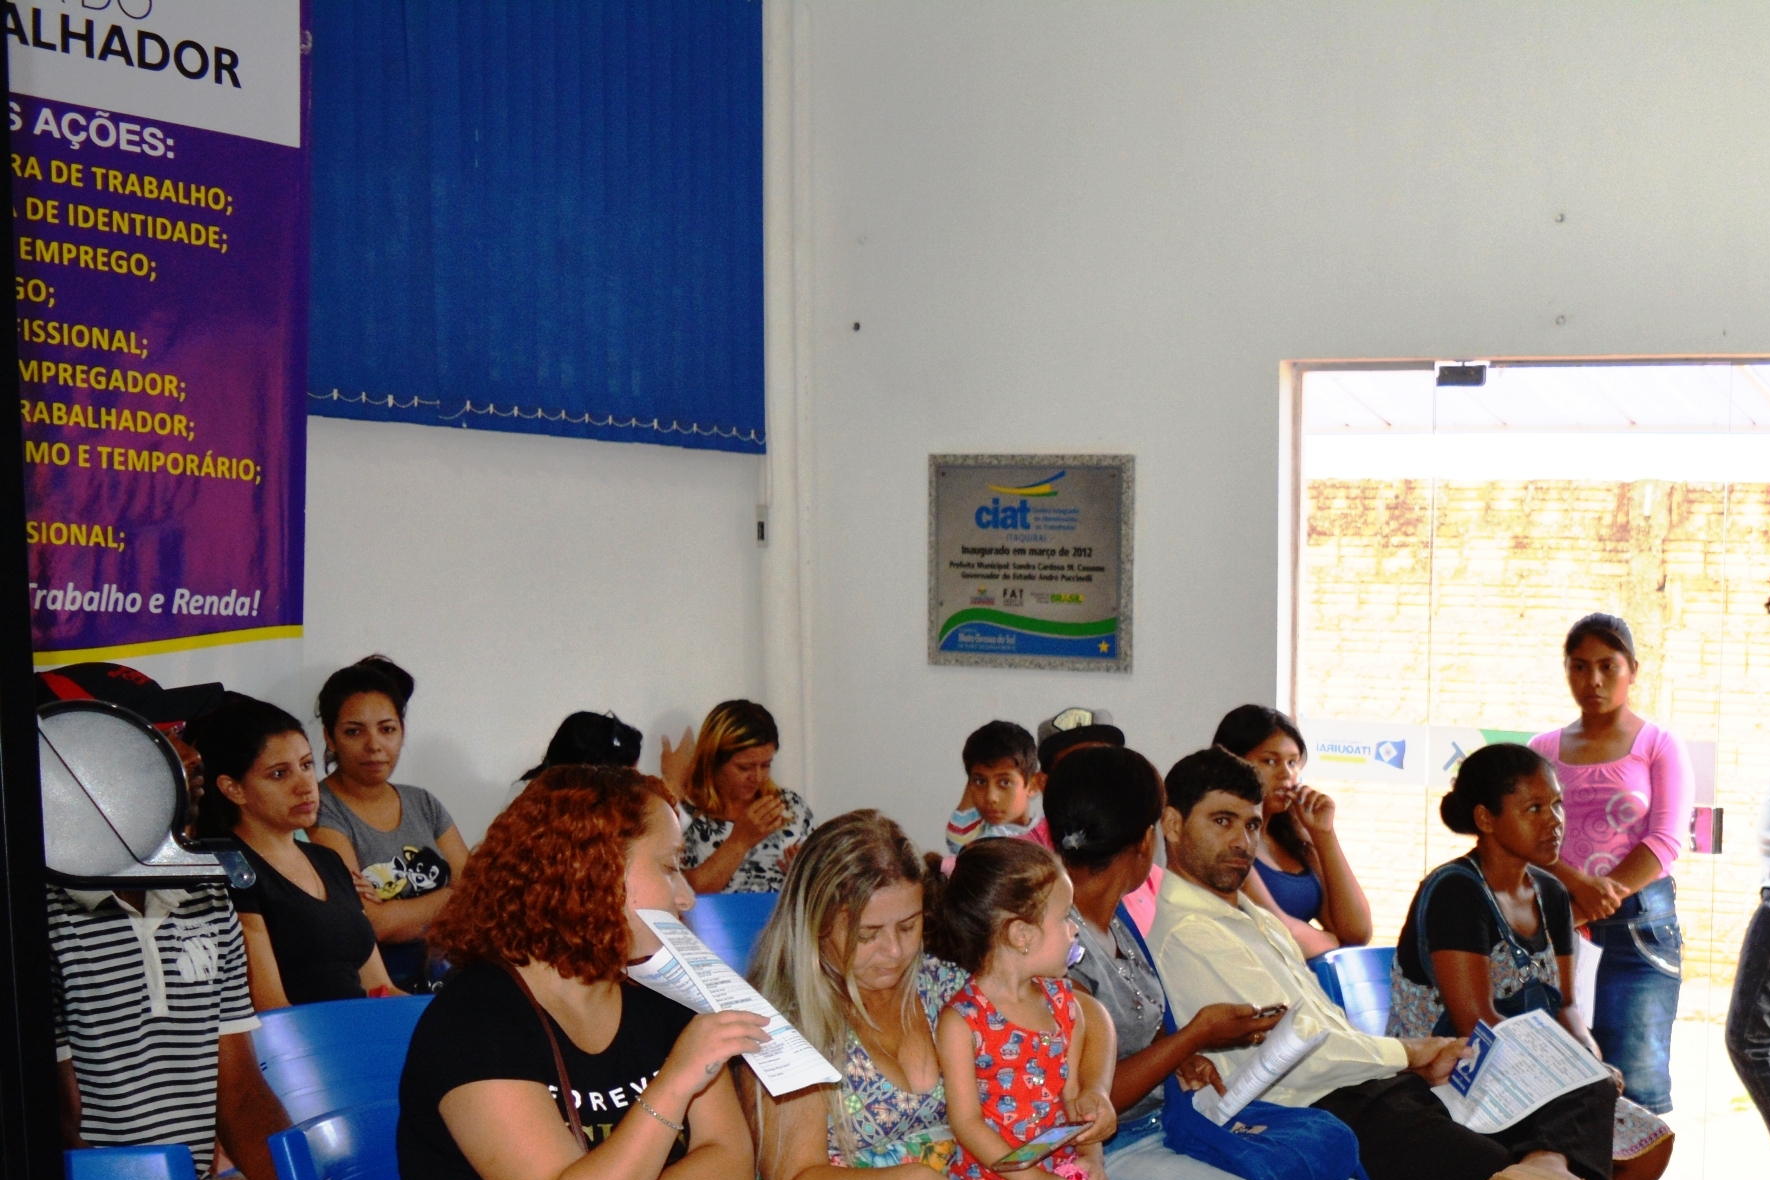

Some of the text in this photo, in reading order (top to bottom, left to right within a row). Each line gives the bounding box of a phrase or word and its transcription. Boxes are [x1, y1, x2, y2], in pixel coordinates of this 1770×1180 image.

[33, 107, 175, 159] AÇÕES:
[50, 159, 84, 188] DE
[91, 166, 234, 216] TRABALHO;
[26, 196, 229, 254] DE IDENTIDADE;
[19, 236, 157, 282] EMPREGO;
[78, 444, 91, 467] E
[97, 446, 262, 485] TEMPORÁRIO;
[975, 498, 1031, 530] ciat
[960, 545, 1093, 559] Inaugurado em março de 2012
[149, 593, 165, 614] e
[171, 588, 261, 617] Renda!
